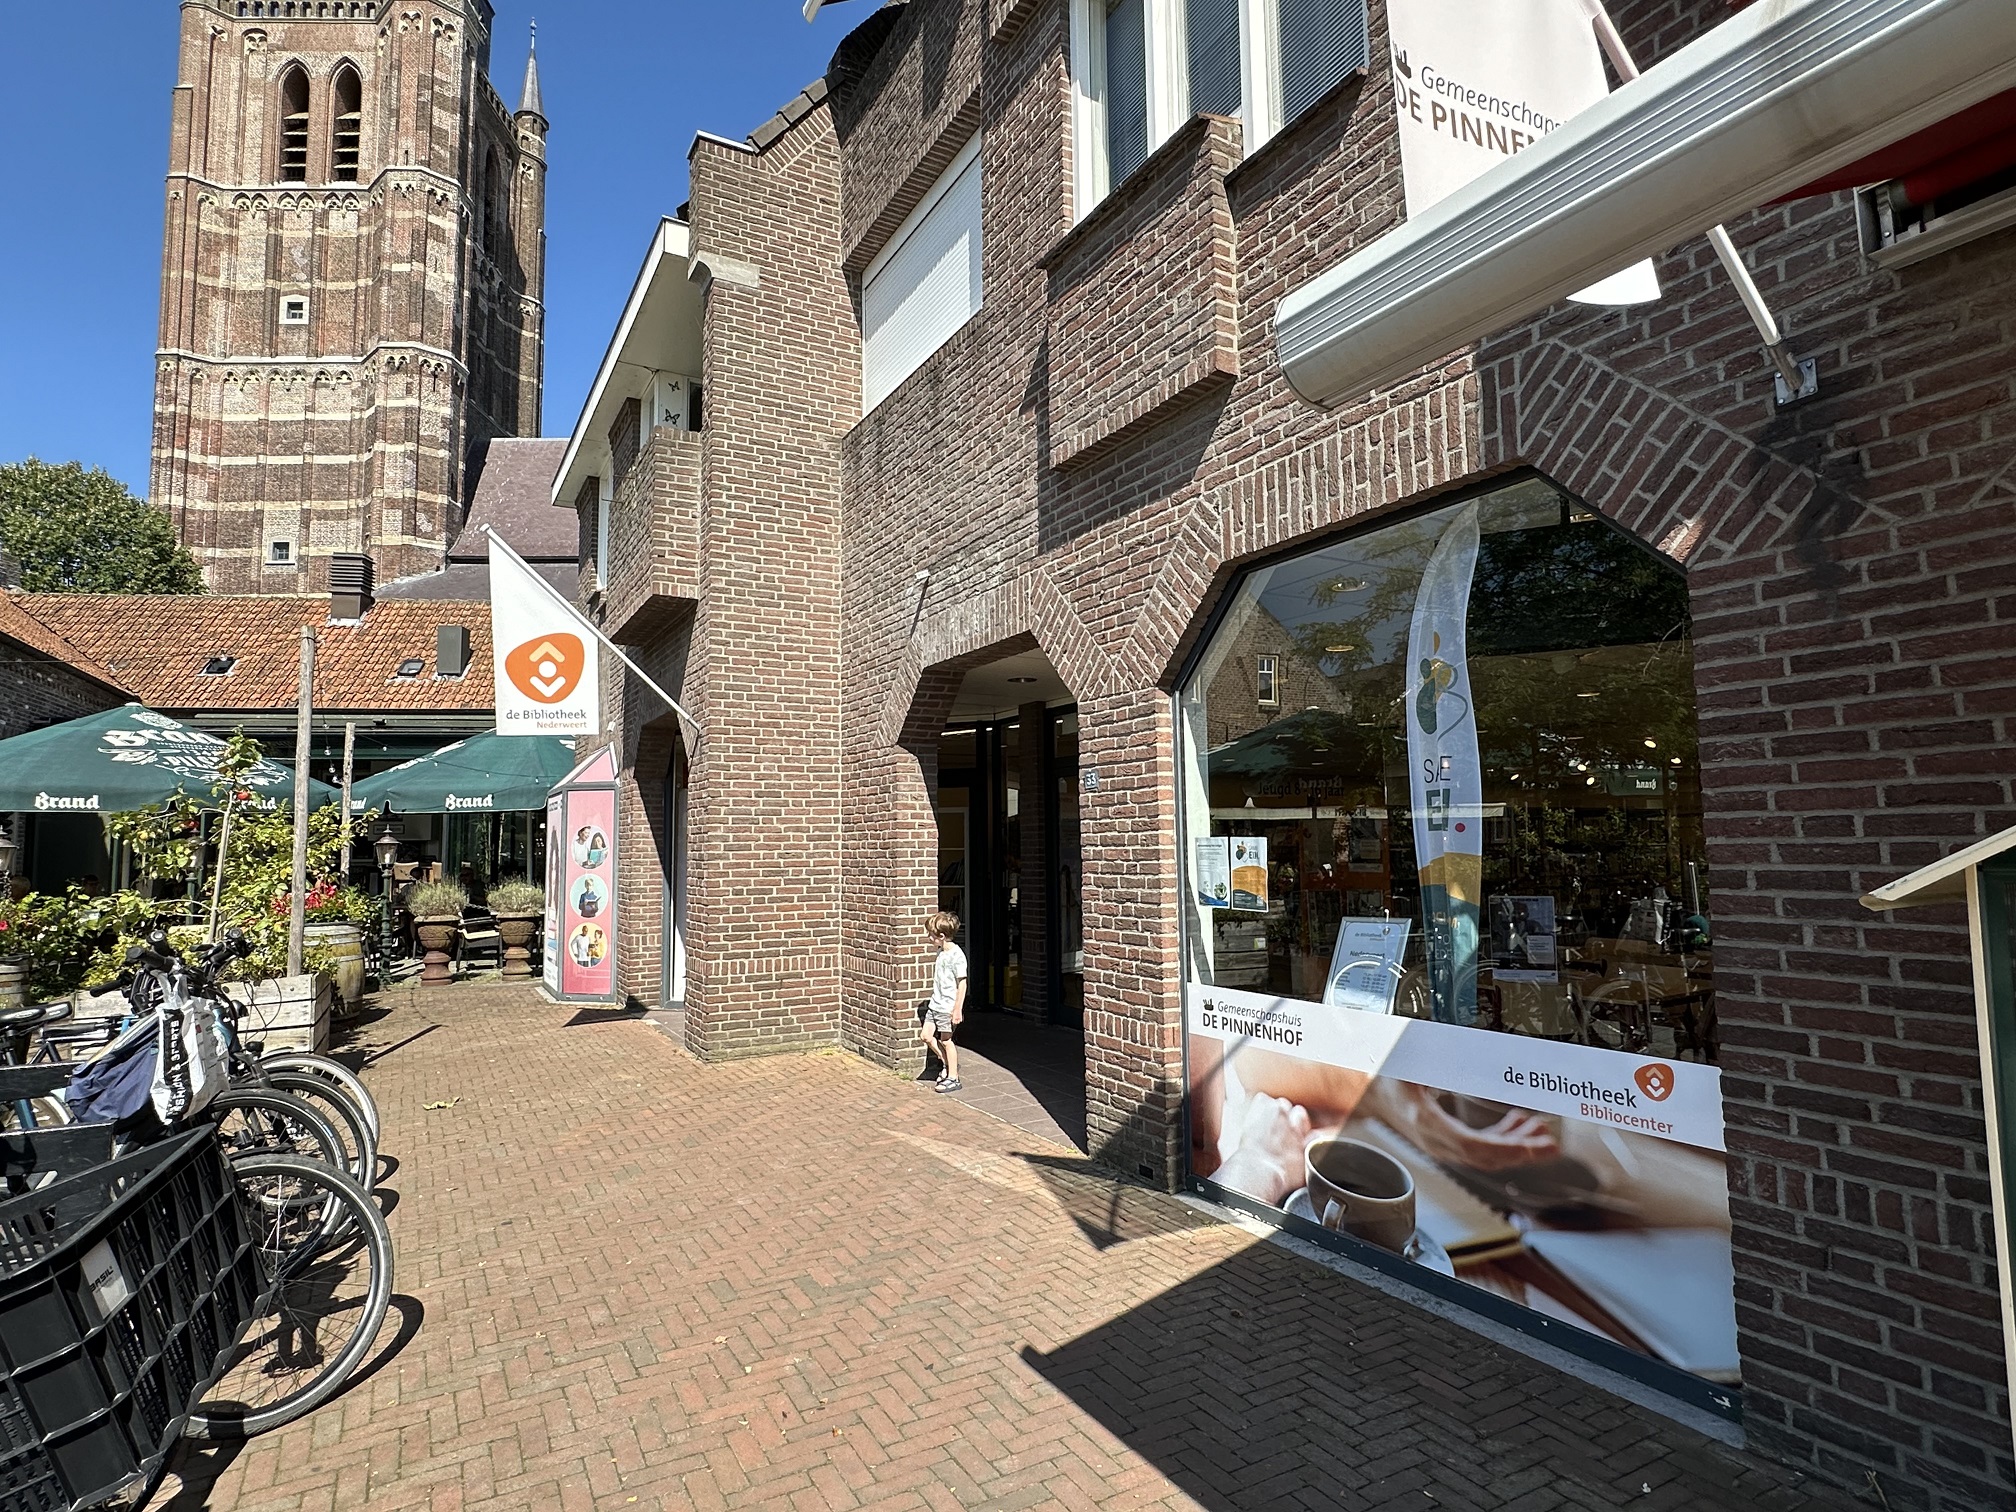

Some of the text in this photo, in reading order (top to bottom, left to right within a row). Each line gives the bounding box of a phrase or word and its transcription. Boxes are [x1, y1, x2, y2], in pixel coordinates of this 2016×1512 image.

[1396, 73, 1536, 155] DE PINNE
[1421, 66, 1563, 135] Gemeenschap
[506, 709, 587, 720] de Bibliotheek
[536, 721, 588, 729] Nederweert
[34, 791, 100, 810] Brand
[445, 794, 494, 810] Brand
[1217, 1000, 1302, 1027] Gemeenschapshuis
[1202, 1012, 1303, 1046] DE PINNENHOF
[1503, 1066, 1638, 1108] de Bibliotheek
[1580, 1103, 1674, 1134] Bibliocenter
